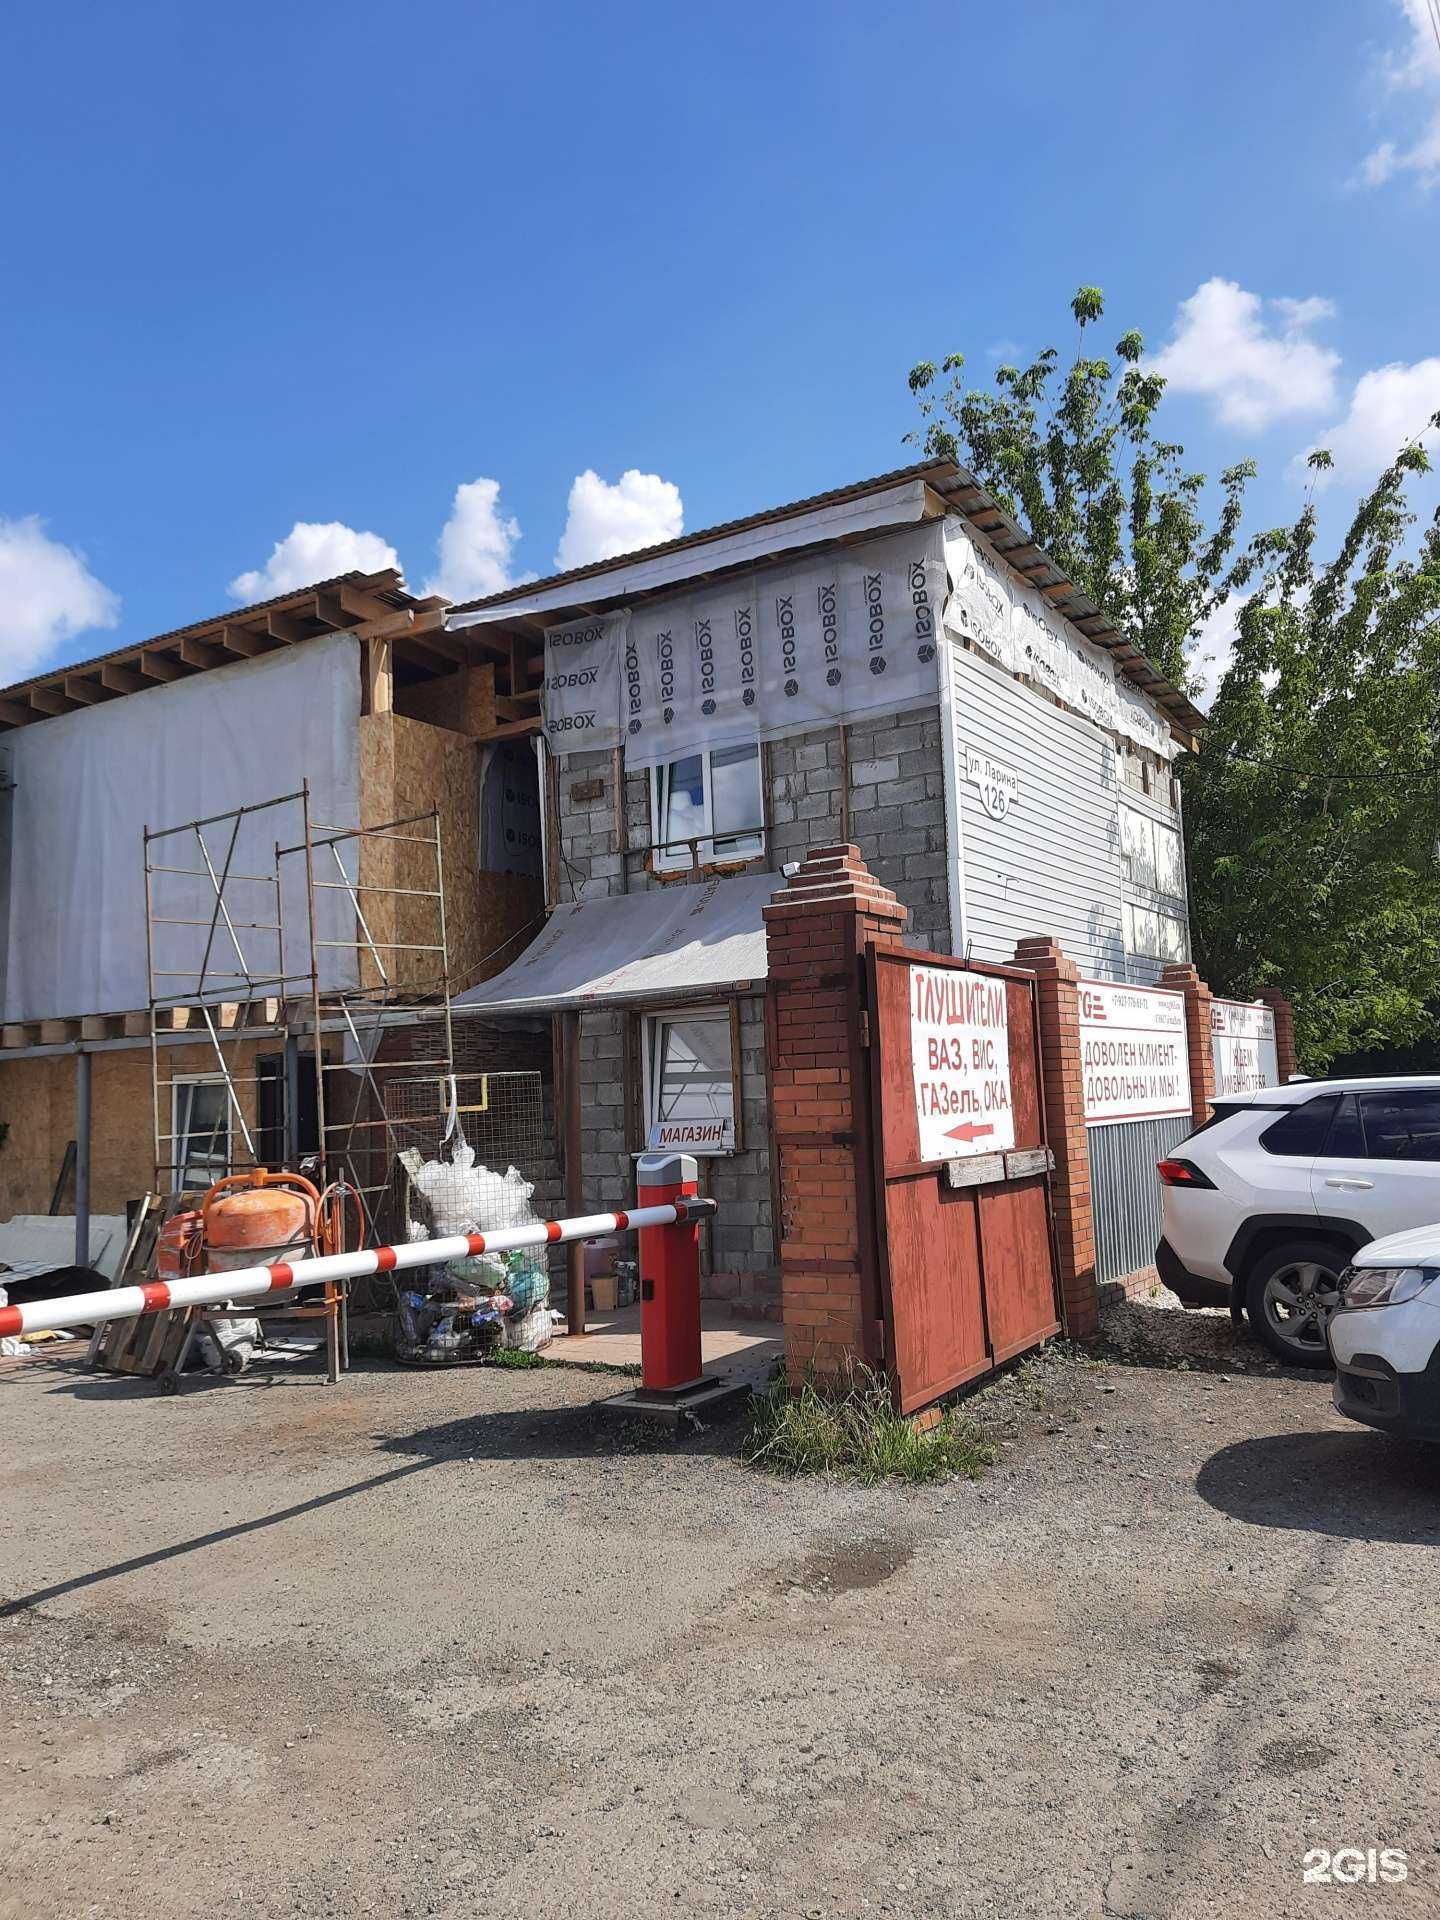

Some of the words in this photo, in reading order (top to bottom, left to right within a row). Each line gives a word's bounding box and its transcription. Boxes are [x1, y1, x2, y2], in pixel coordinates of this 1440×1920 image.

[985, 760, 1016, 789] Ларина
[984, 783, 1005, 813] 126
[915, 974, 1004, 1029] ГЛУШИТЕЛИ
[928, 1038, 968, 1077] ВАЗ,
[972, 1039, 998, 1075] ВИС,
[1085, 1041, 1137, 1073] ДОВОЛЕН
[984, 1080, 1009, 1111] ОКА
[1087, 1075, 1148, 1109] ДОВОЛЬНЫ
[1150, 1075, 1157, 1098] И
[659, 1125, 721, 1143] МАГАЗИН
